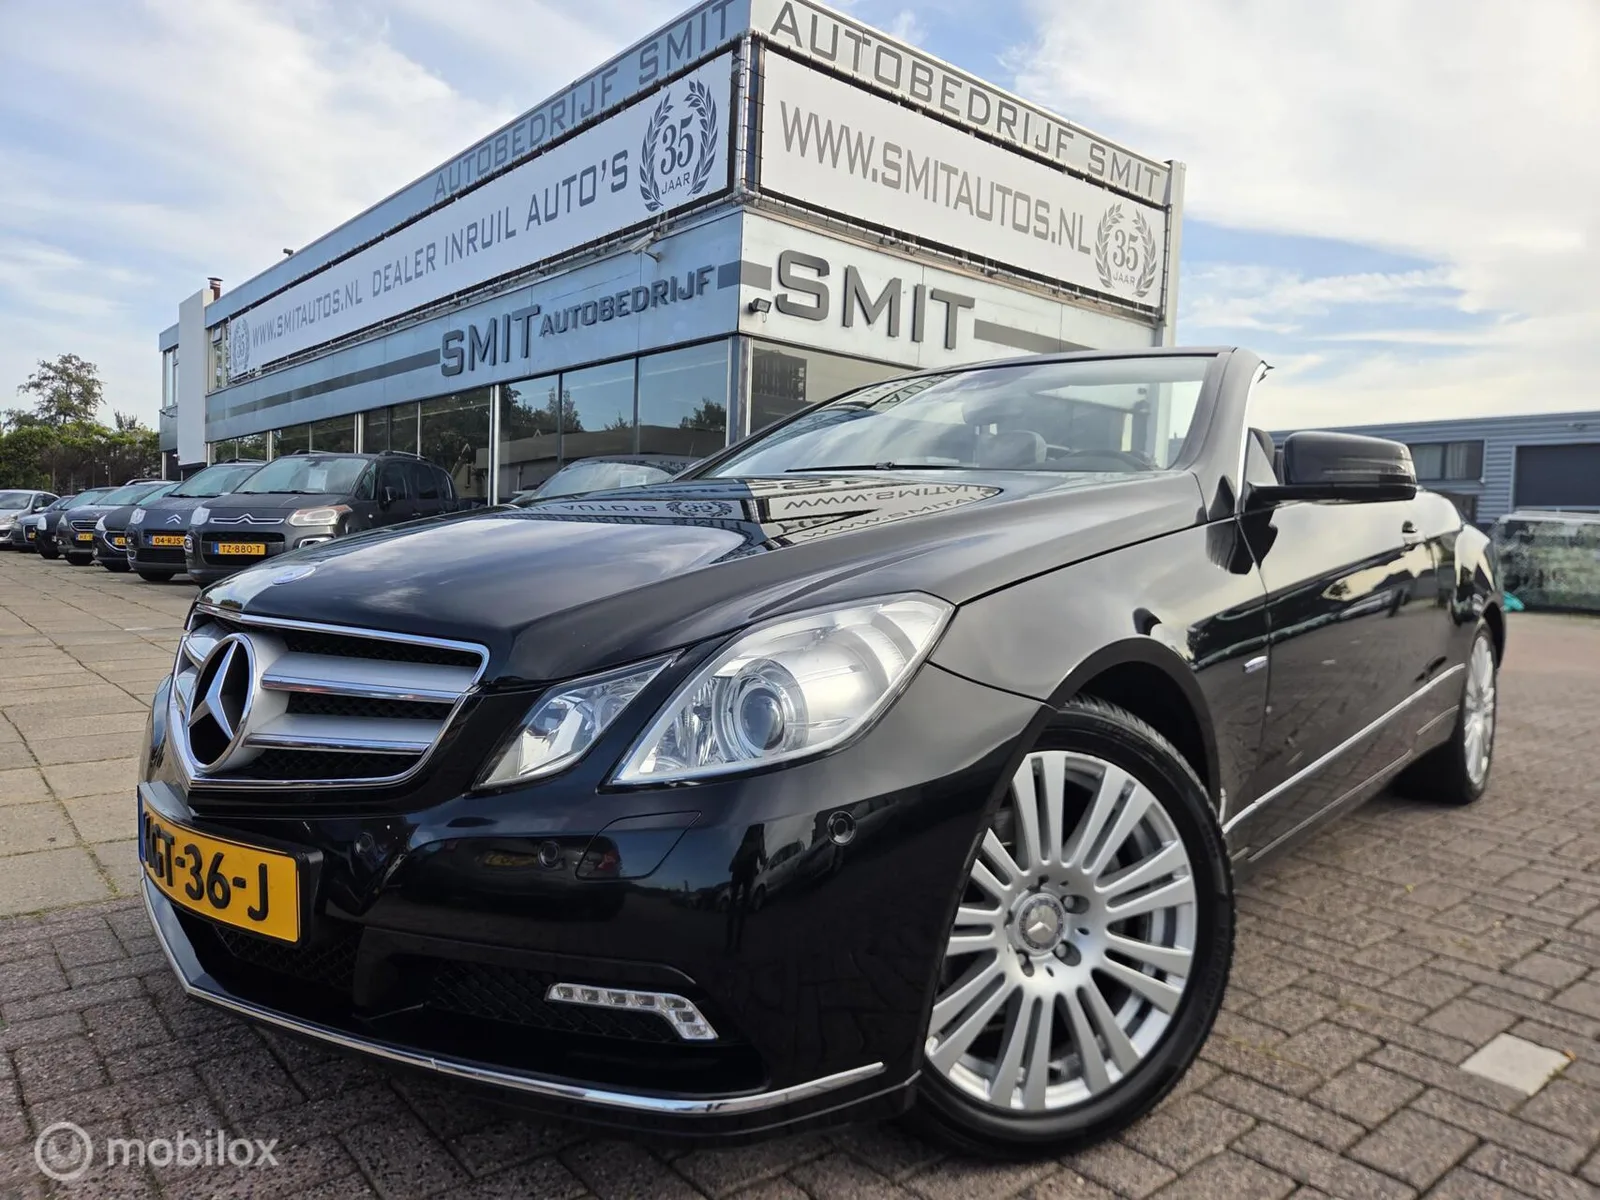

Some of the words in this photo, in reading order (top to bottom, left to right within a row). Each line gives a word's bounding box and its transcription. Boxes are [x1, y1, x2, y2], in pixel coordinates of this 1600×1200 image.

[433, 66, 619, 201] AUTOBEDRIJF
[638, 0, 736, 85] SMIT
[770, 1, 1074, 159] AUTOBEDRIJF
[1087, 142, 1161, 198] SMIT
[660, 114, 694, 176] 35
[661, 171, 691, 195] JAAR
[780, 100, 1091, 255] WWW.SMITAUTOS.NL
[252, 287, 363, 349] WWW.SMITAUTOS.NL
[372, 241, 436, 297] DEALER
[444, 206, 517, 266] INRUIL
[525, 149, 628, 231] AUTO'S
[1112, 229, 1139, 271] 35
[1112, 272, 1136, 286] JAAR
[440, 303, 541, 377] SMIT
[539, 264, 717, 337] AUTOBEDRIJF
[776, 249, 976, 350] SMIT
[154, 537, 185, 545] 04-RJS-
[221, 544, 261, 554] TZ-880-T
